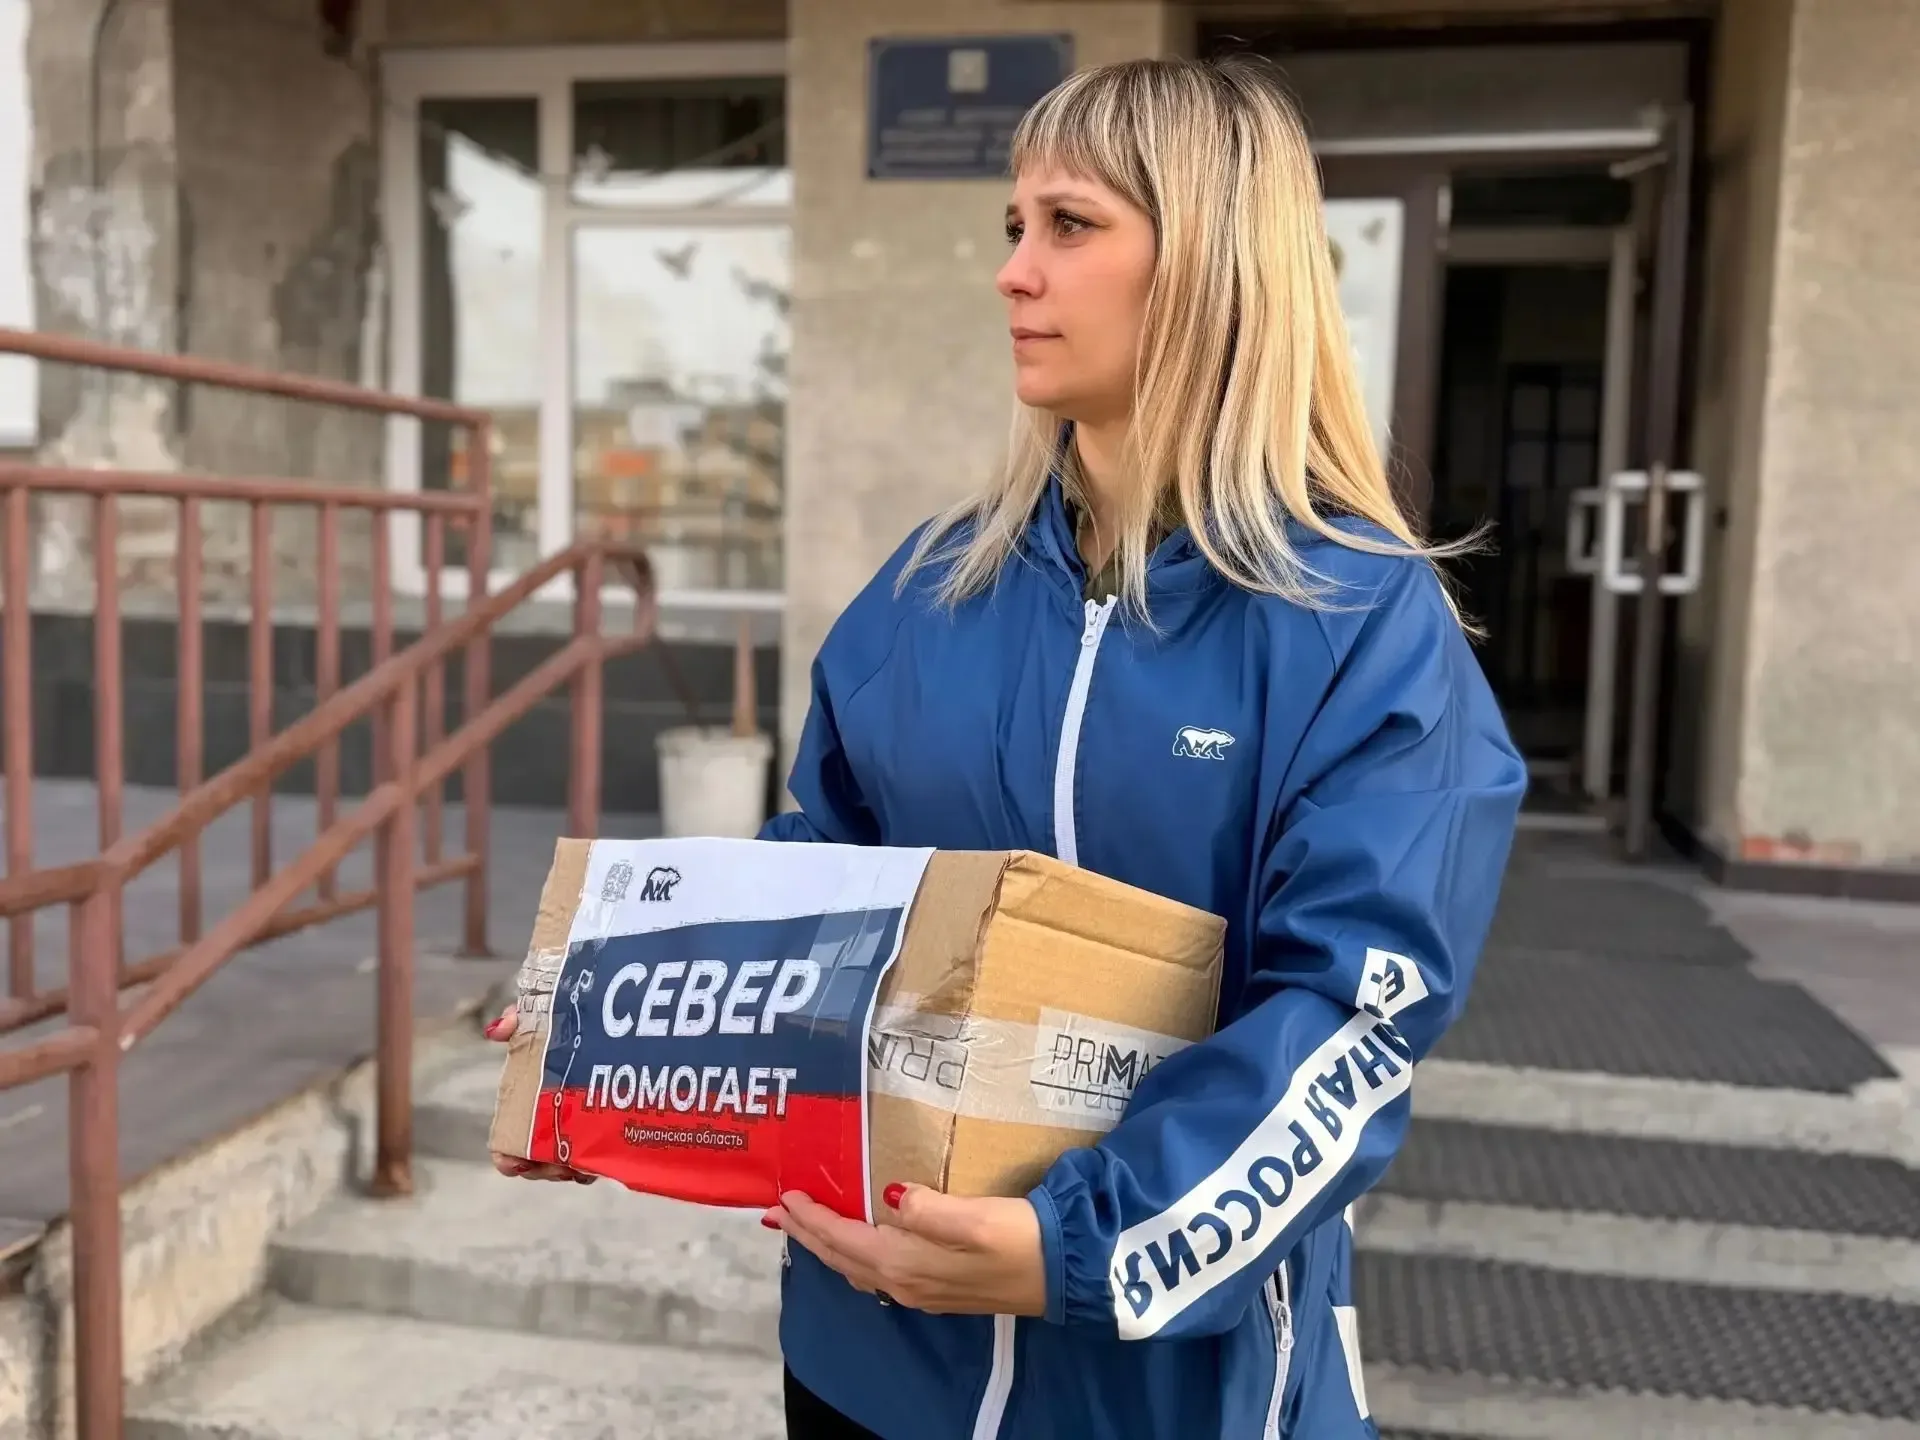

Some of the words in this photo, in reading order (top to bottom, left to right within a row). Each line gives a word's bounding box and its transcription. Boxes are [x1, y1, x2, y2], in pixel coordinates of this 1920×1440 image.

[602, 959, 821, 1038] СЕВЕР
[1050, 1033, 1165, 1090] PRIMA
[1304, 958, 1413, 1142] ЕНАЯ
[585, 1064, 797, 1116] ПОМОГАЕТ
[624, 1125, 693, 1144] Мурманская
[696, 1130, 744, 1146] область
[1114, 1119, 1323, 1319] РОССИЯ
